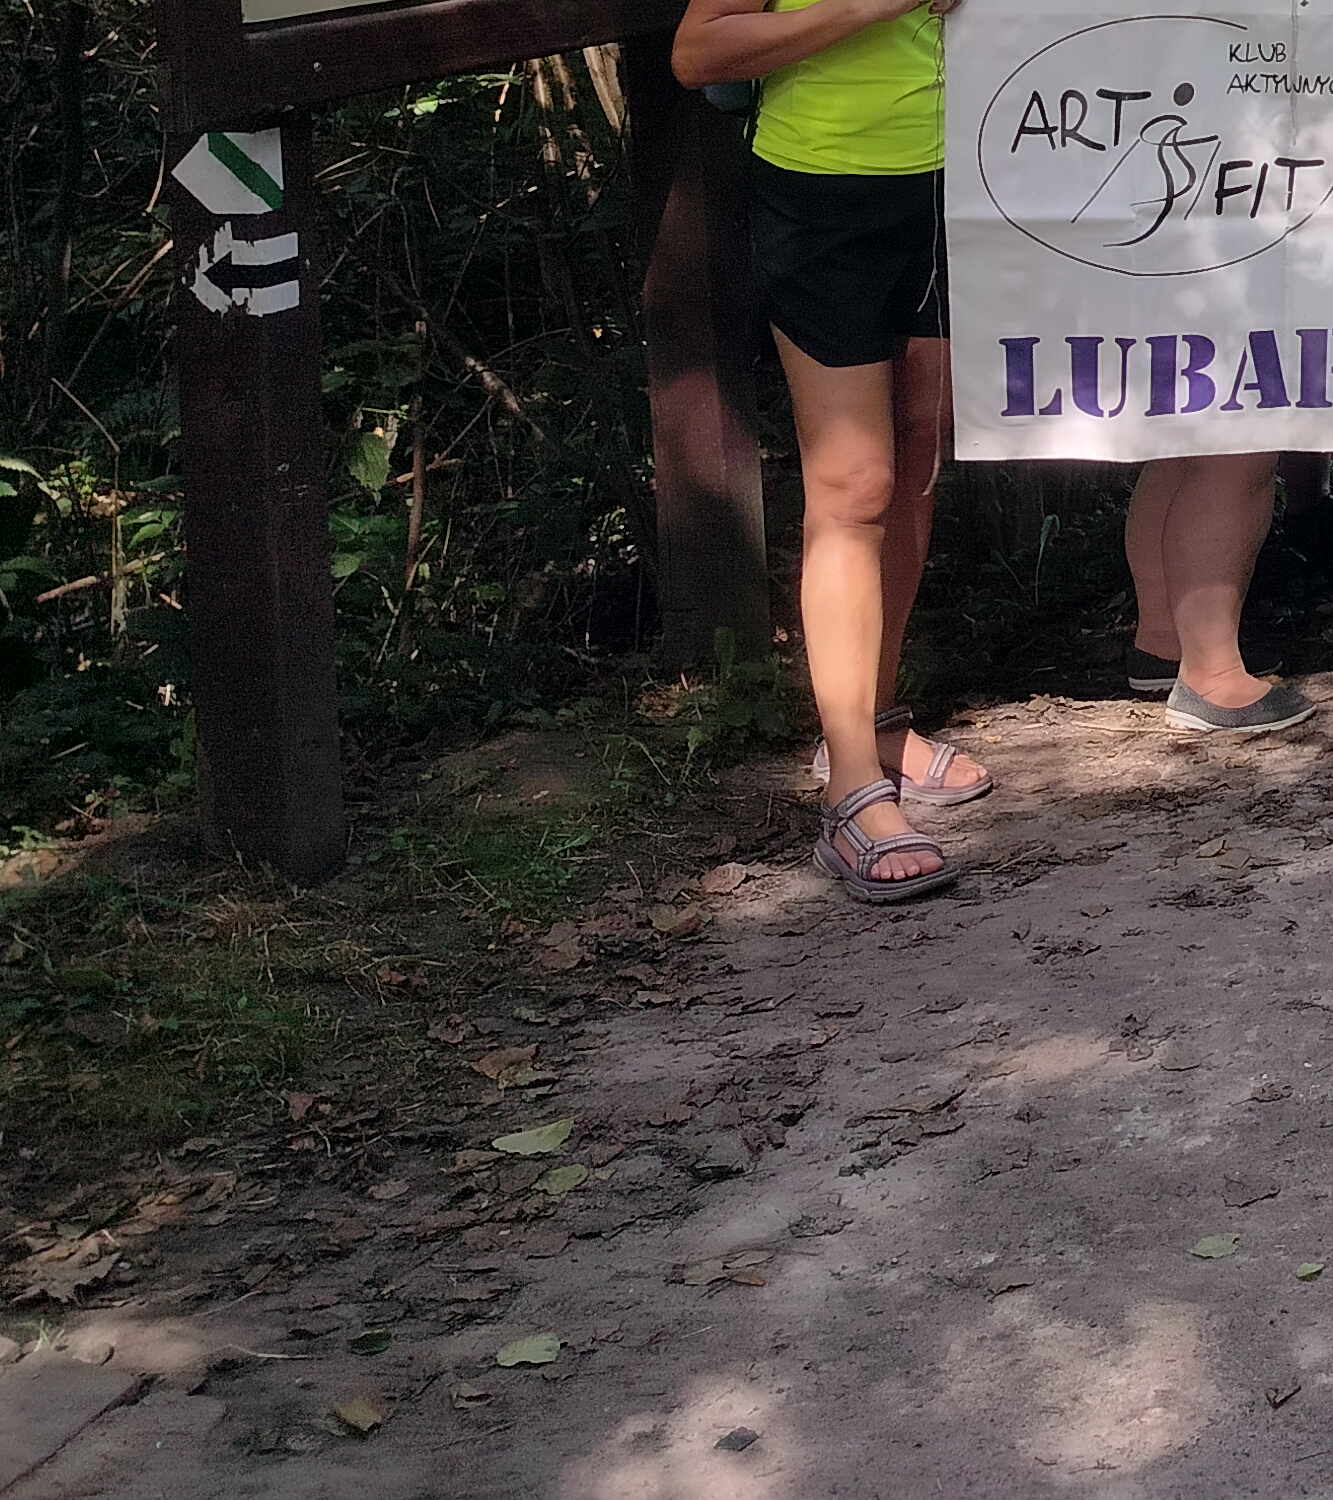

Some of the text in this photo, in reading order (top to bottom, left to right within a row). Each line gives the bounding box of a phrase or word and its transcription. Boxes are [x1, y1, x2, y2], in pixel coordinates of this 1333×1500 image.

[1228, 42, 1287, 63] KLUB
[1011, 88, 1152, 154] ART
[1215, 158, 1324, 221] FIT
